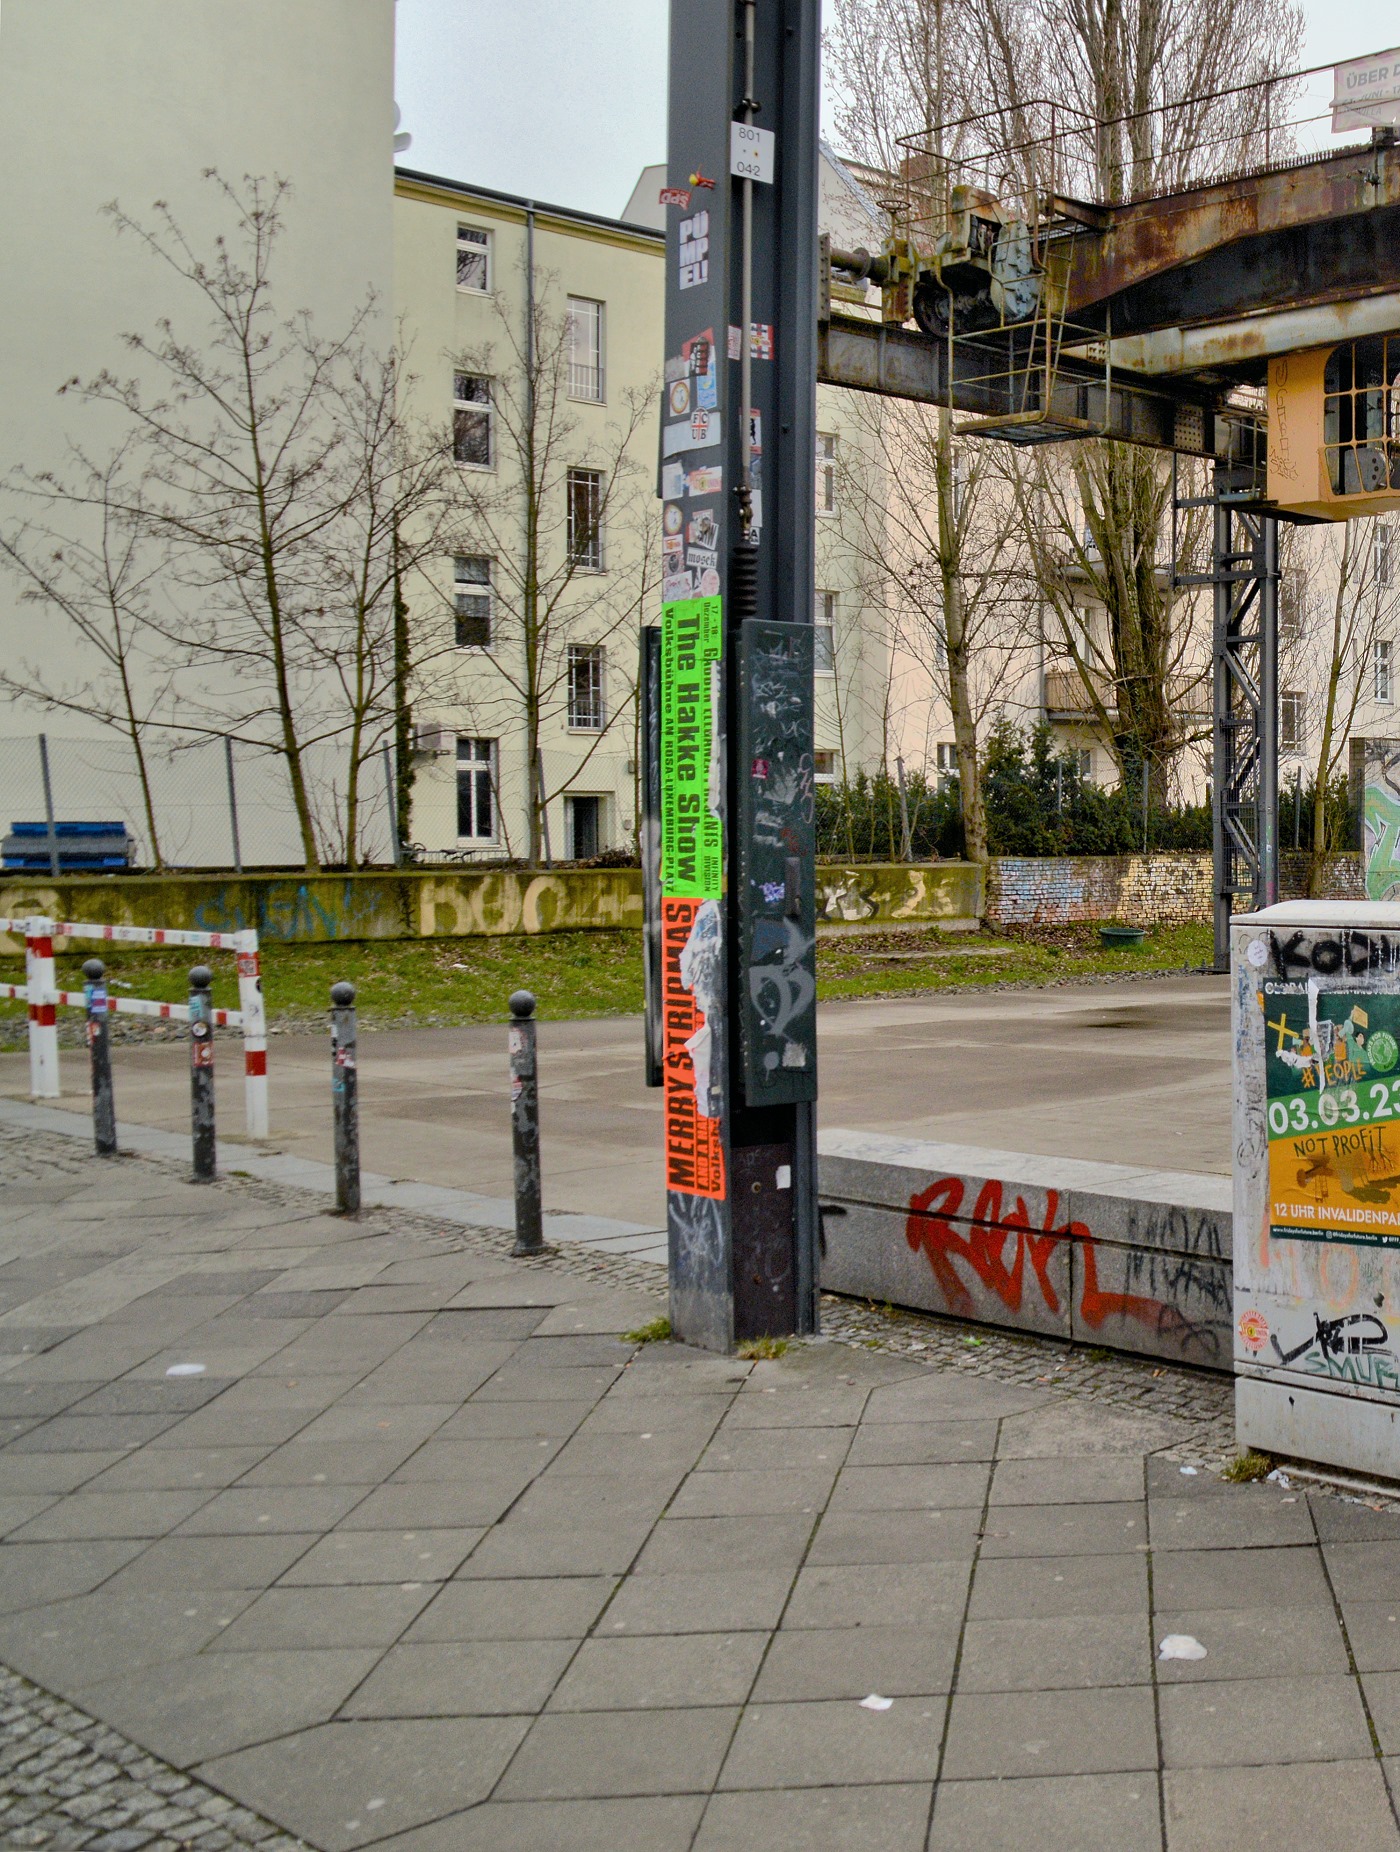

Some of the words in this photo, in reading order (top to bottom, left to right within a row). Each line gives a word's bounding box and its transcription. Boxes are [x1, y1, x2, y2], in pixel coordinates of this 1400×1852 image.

[1346, 65, 1389, 90] ÜBER
[739, 127, 761, 143] 801
[679, 210, 709, 244] PÜ
[679, 237, 709, 268] MP
[679, 260, 709, 291] EL!
[703, 601, 711, 643] Dezember
[676, 613, 701, 671] The
[664, 607, 675, 714] Volksbühne
[676, 682, 701, 782] Hakke
[676, 793, 701, 883] Show
[703, 855, 711, 892] DIVISION
[711, 856, 719, 892] INFINITY
[666, 903, 693, 1071] STRIPMAS
[1301, 1057, 1368, 1089] #EOPLE
[667, 1076, 695, 1188] MERRY
[1293, 1136, 1329, 1158] NOT
[1274, 1202, 1288, 1217] 12
[1290, 1205, 1315, 1219] UHR
